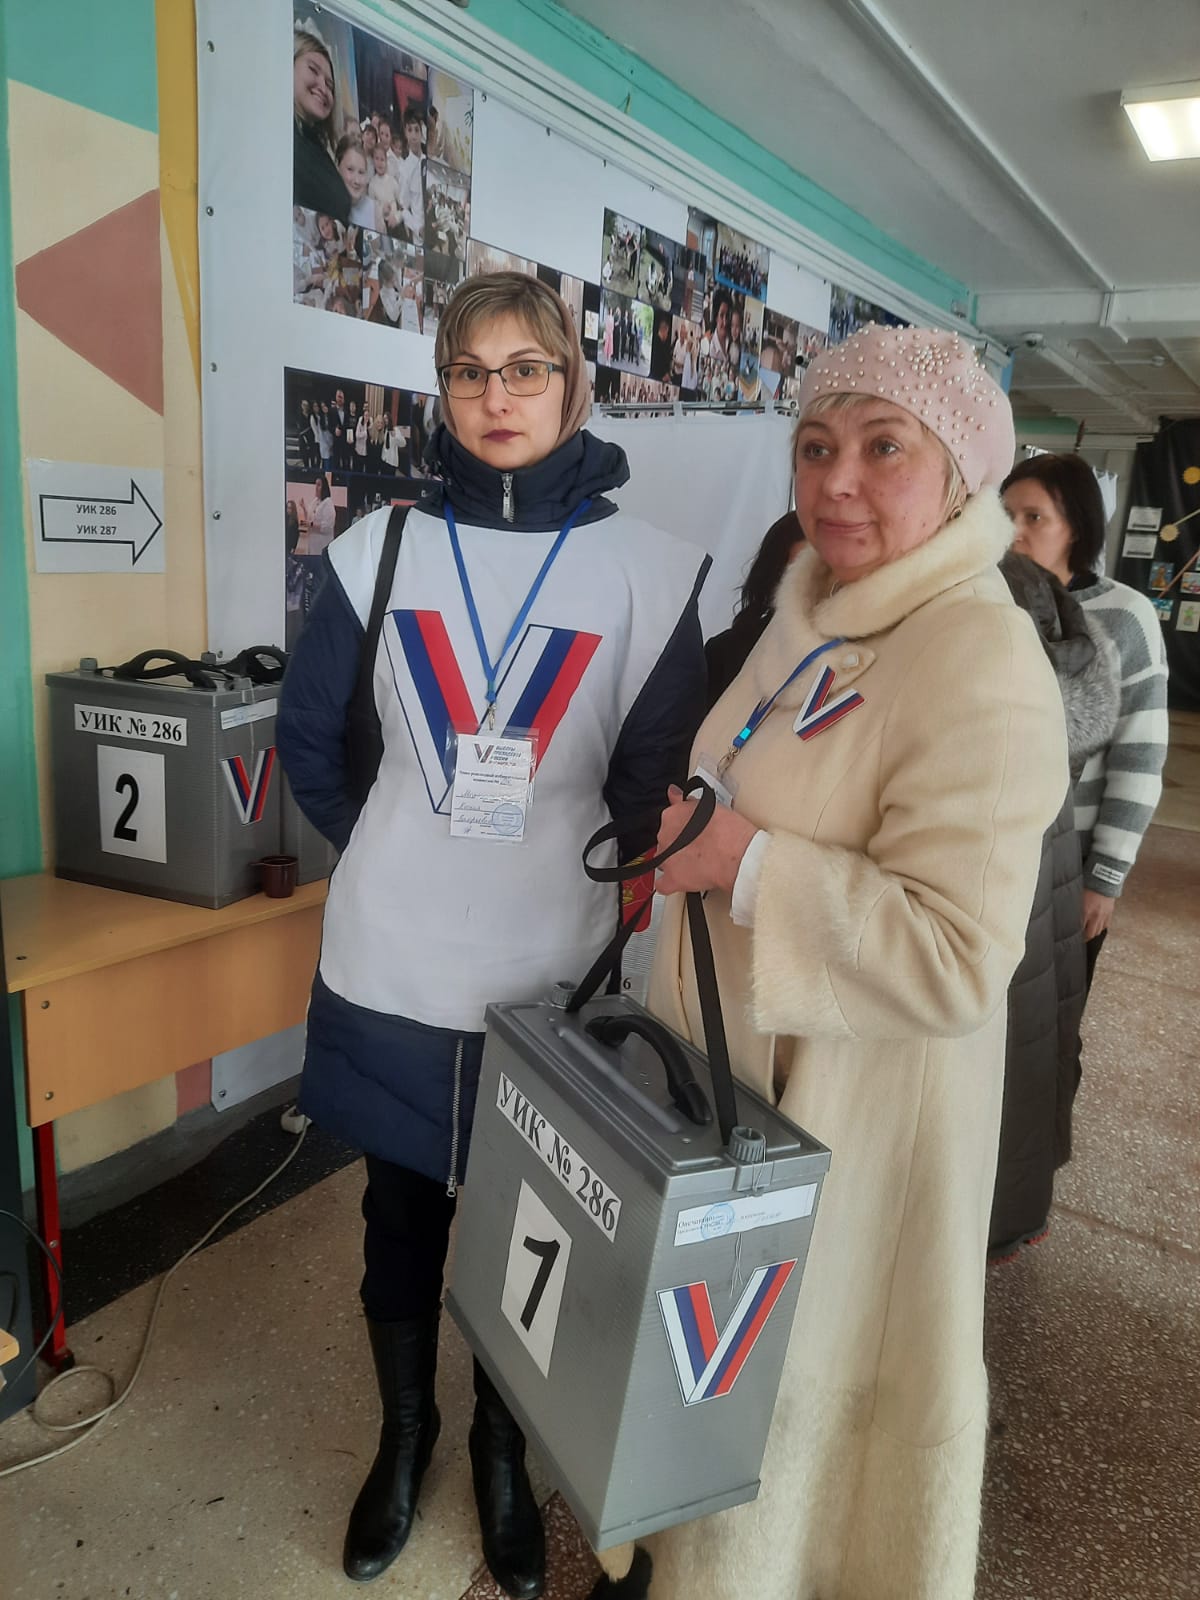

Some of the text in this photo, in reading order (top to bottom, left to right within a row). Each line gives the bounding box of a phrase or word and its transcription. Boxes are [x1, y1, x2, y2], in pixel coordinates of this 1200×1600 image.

[76, 504, 117, 515] УИК 286
[76, 525, 117, 535] УИК 287
[79, 710, 182, 741] УИК № 286
[113, 773, 139, 842] 2
[500, 1074, 621, 1232] УИК № 286
